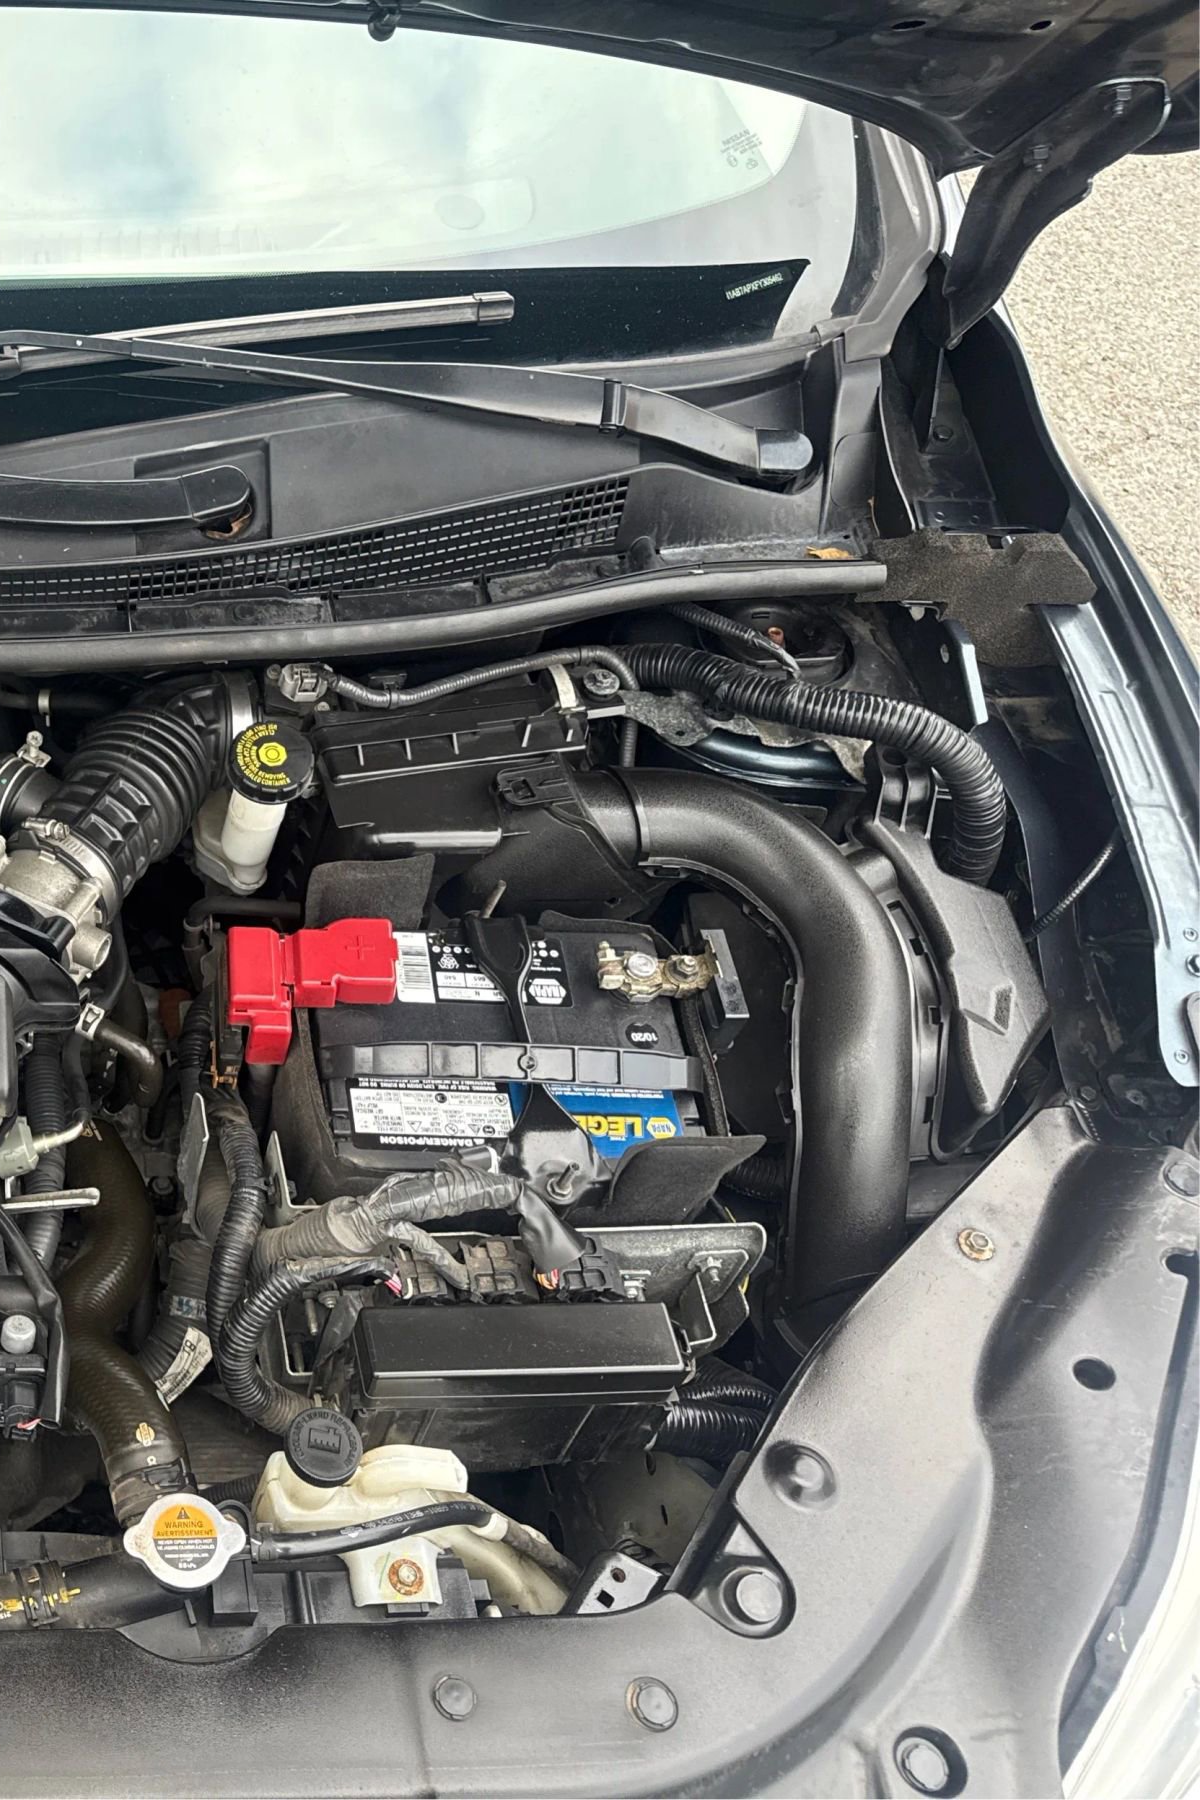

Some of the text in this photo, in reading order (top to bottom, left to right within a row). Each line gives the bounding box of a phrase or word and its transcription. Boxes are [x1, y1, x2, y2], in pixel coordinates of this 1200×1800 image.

[534, 985, 561, 998] NAPA
[631, 1032, 658, 1042] 10/20
[651, 1123, 672, 1133] NAPA
[380, 1136, 473, 1147] DANGER/POISON
